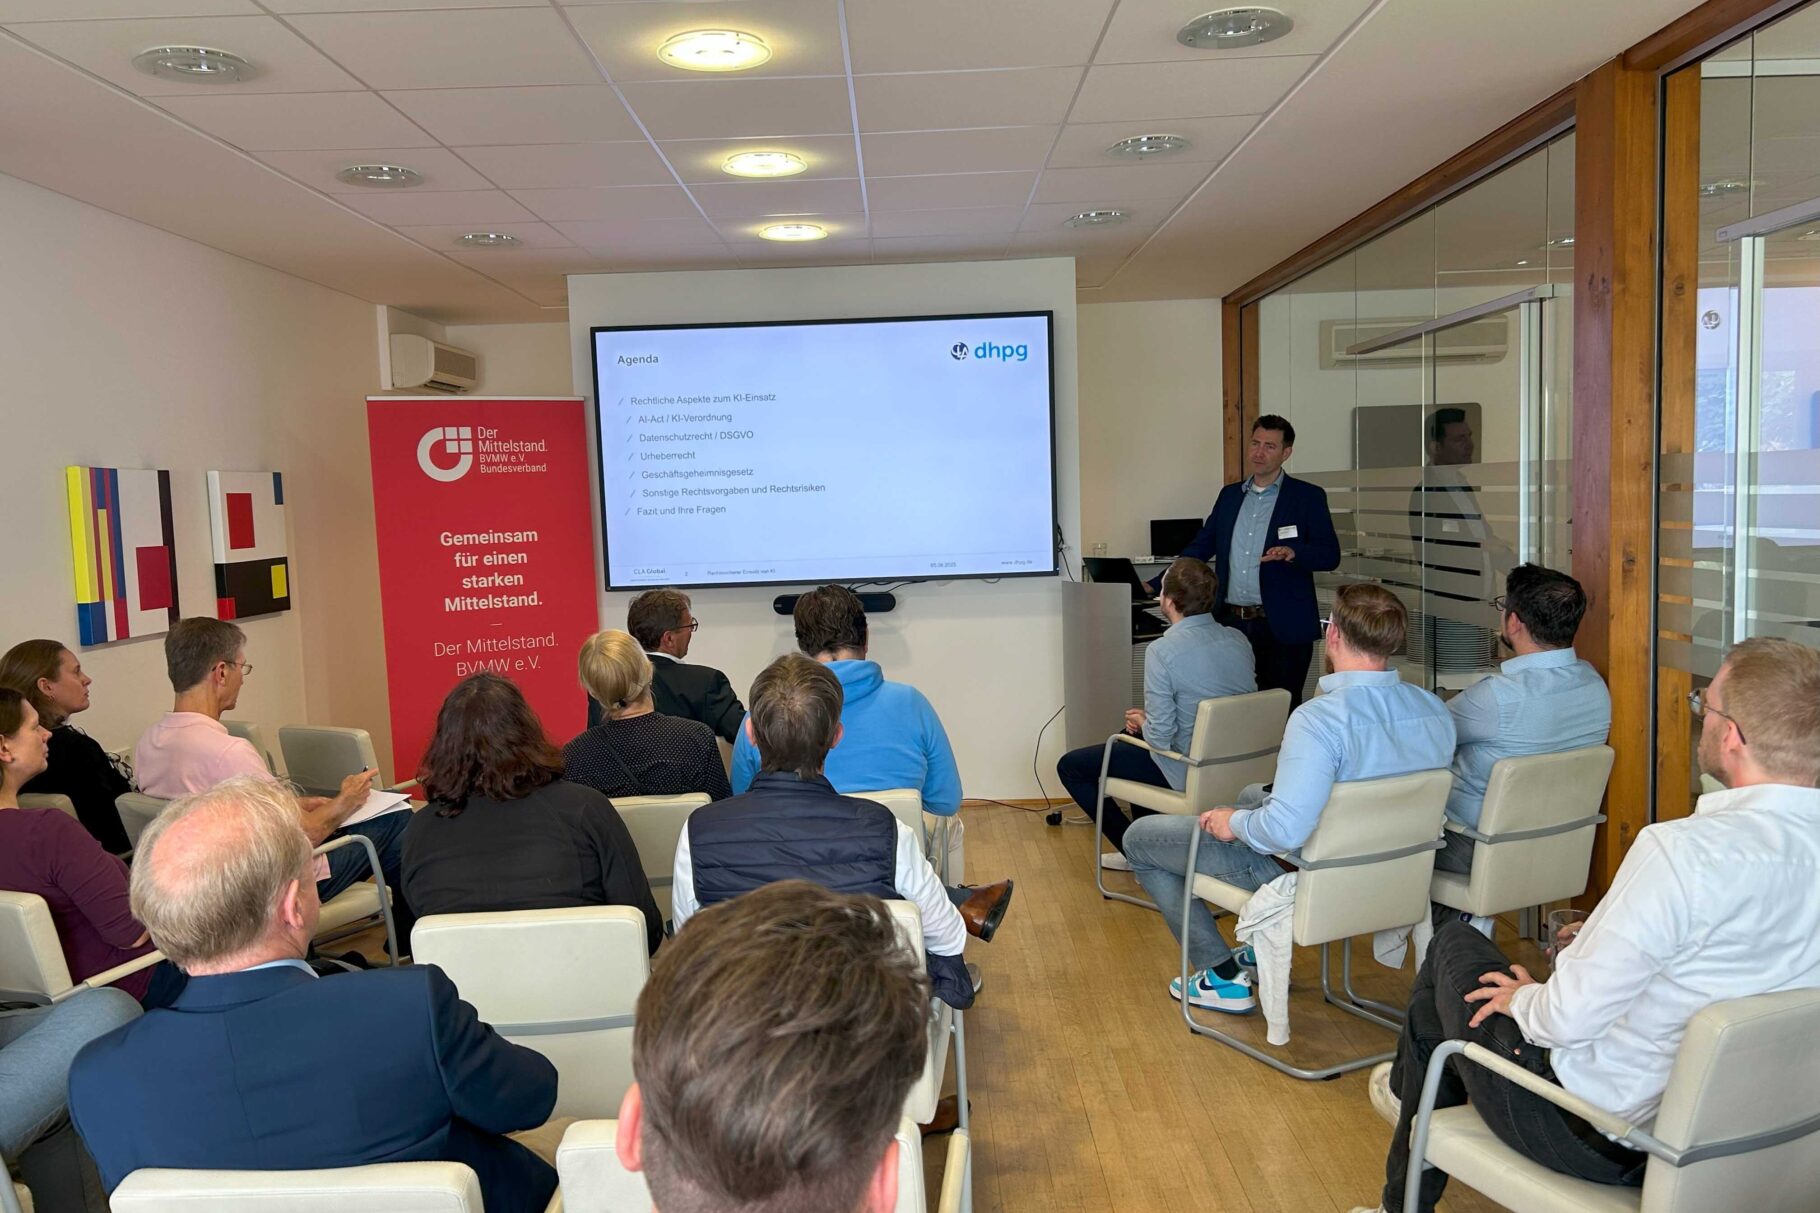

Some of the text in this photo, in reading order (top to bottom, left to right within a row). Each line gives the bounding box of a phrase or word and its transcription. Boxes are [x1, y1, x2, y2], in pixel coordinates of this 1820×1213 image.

[974, 341, 1028, 362] dhpg
[617, 355, 659, 366] Agenda
[630, 393, 777, 406] Rechtliche Aspekte zum KI-Einsatz
[638, 414, 664, 424] AI-Act
[671, 413, 733, 423] KI-Verordnung
[477, 426, 499, 439] Der
[639, 432, 713, 443] Datenschutzrecht
[719, 430, 754, 440] DSGVO
[478, 439, 548, 453] Mittelstand.
[479, 453, 526, 463] BVMW e.V.
[640, 451, 696, 461] Urheberrecht
[480, 463, 547, 474] Bundesverband
[641, 468, 754, 480] Geschäftsgeheimnisgesetz
[642, 484, 826, 499] Sonstige Rechtsvorgaben und Rechtsrisiken
[637, 505, 727, 516] Fazit und Ihre Fragen
[440, 529, 538, 546] Gemeinsam
[454, 551, 528, 568] für einen
[462, 572, 524, 589] starken
[444, 591, 543, 612] Mittelstand.
[434, 632, 559, 657] Der Mittelstand.
[456, 655, 542, 677] BVMW e.V.
